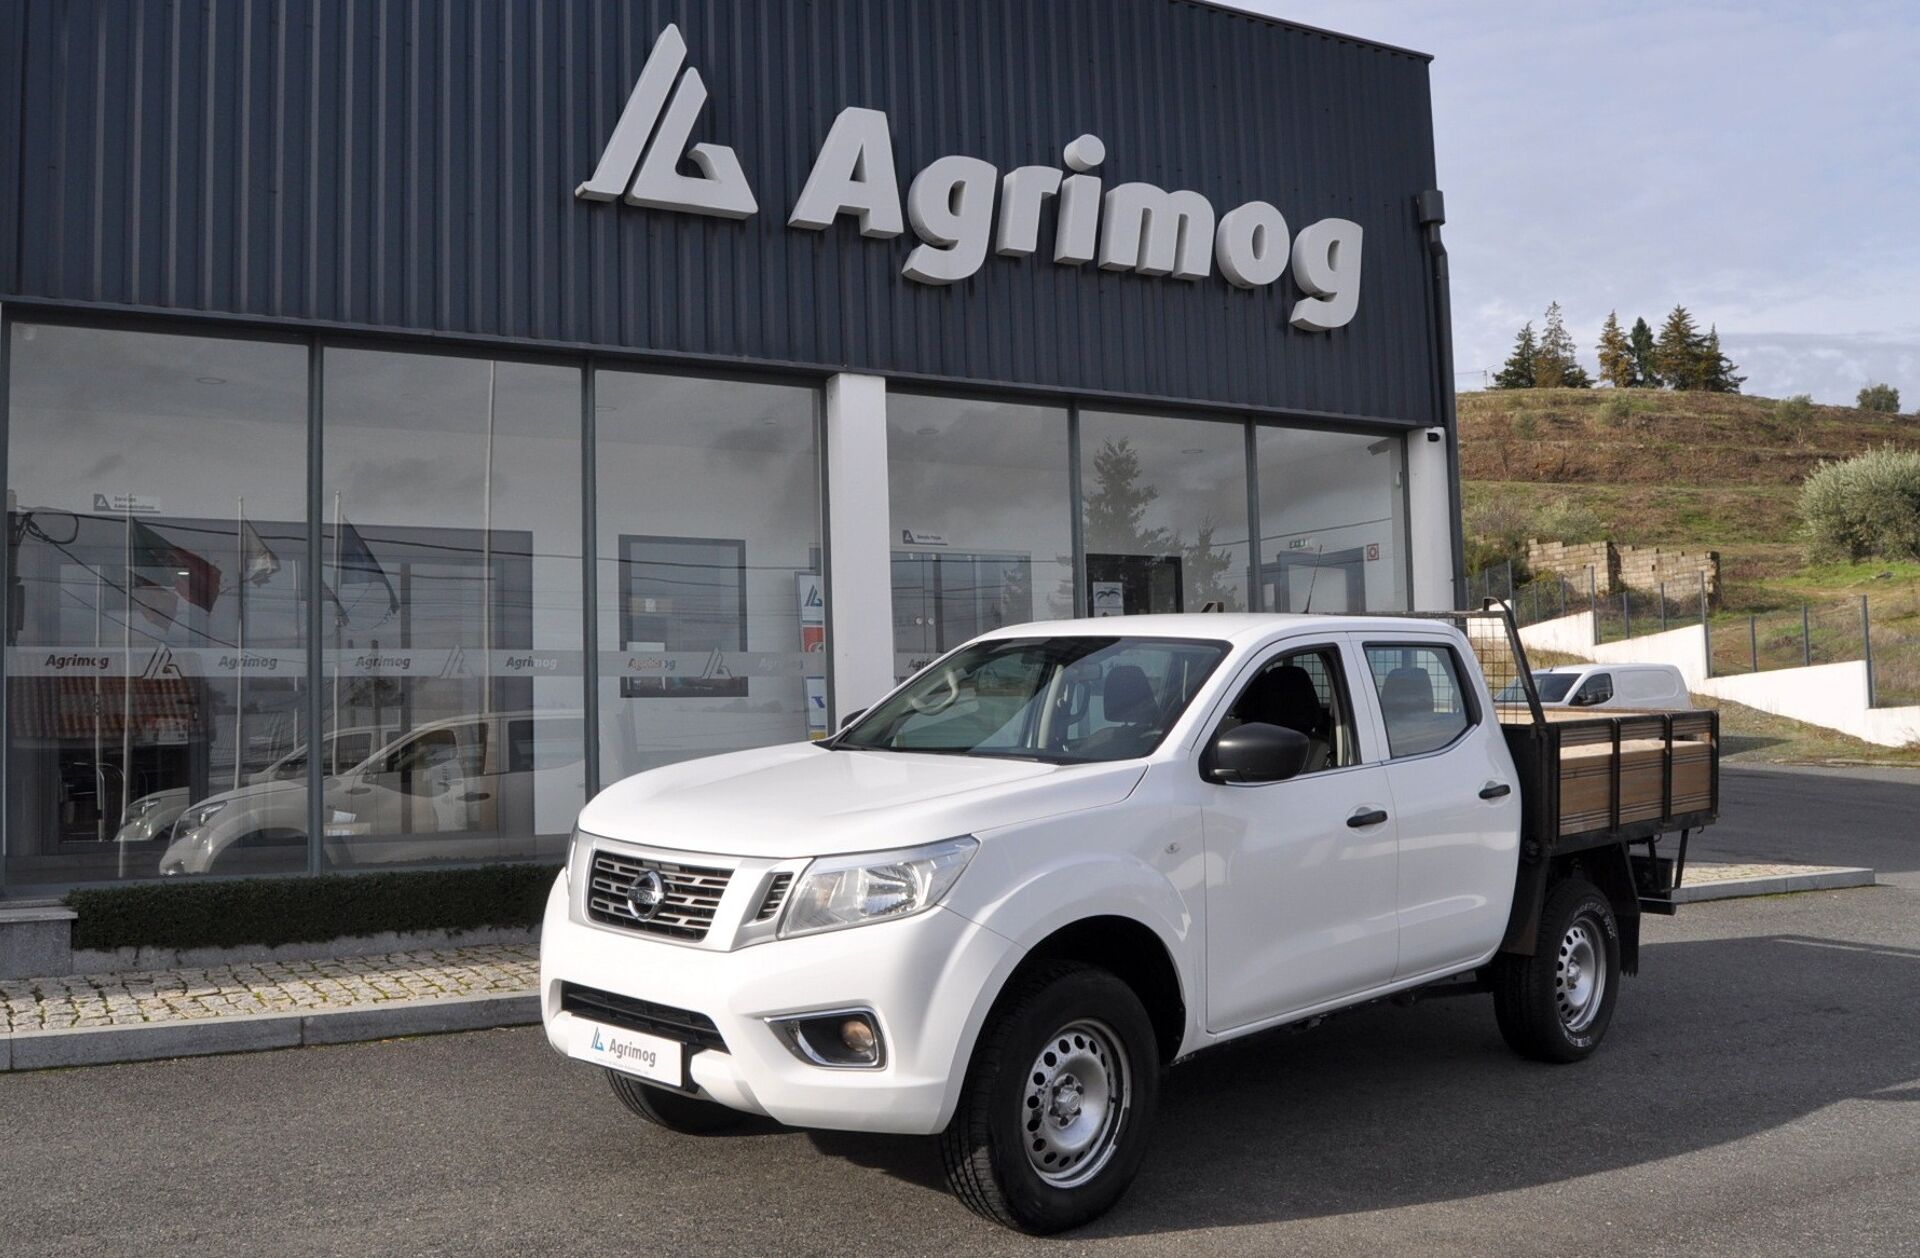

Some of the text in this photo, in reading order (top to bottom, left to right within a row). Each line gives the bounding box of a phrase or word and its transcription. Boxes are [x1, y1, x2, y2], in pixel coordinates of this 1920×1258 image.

[787, 106, 1363, 332] Agrimog
[45, 654, 109, 669] Agrimog
[218, 655, 277, 669] Agrimog
[355, 656, 411, 669] Agrimog
[506, 656, 557, 670] Agrimog
[609, 1038, 656, 1068] Agrimog
